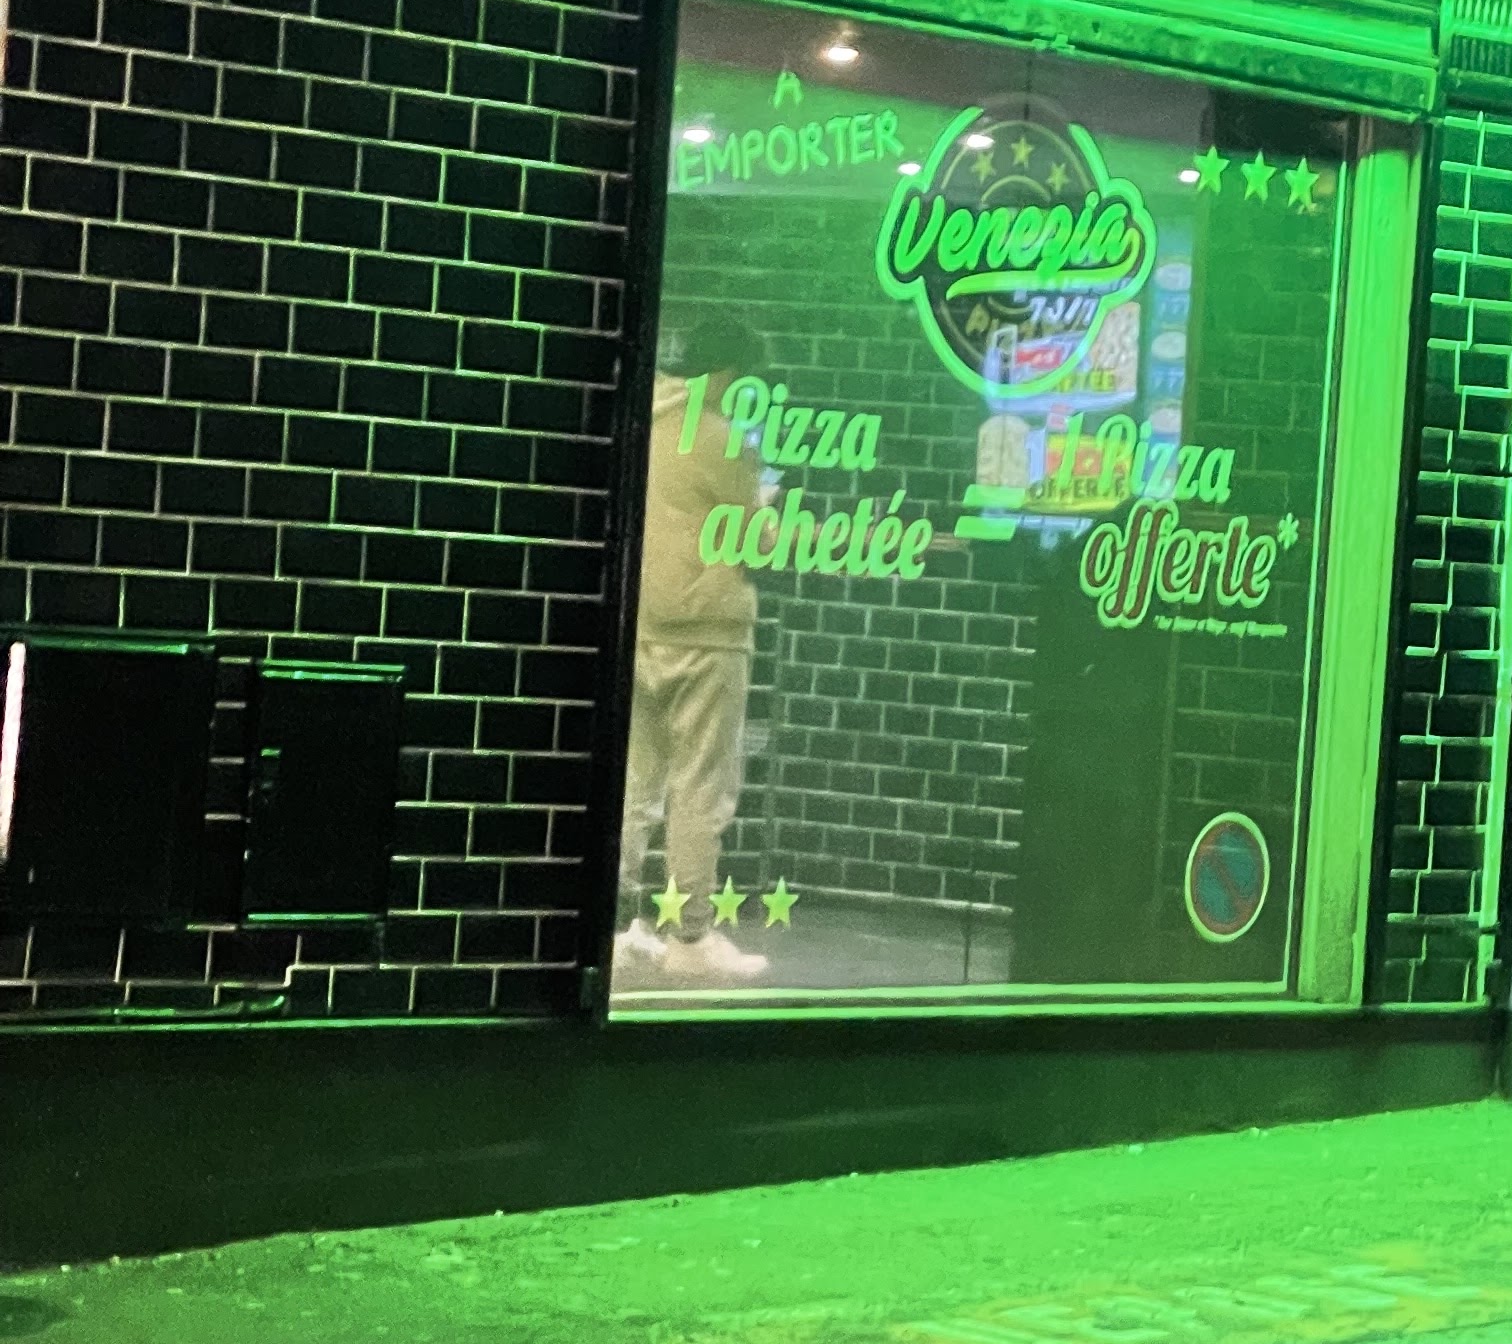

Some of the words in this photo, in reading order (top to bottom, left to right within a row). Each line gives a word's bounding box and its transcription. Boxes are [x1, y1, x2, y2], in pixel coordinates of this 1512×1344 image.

[676, 109, 905, 191] EMPORTER
[894, 191, 1140, 281] Venezia
[678, 374, 709, 457] 1
[721, 377, 883, 473] Pizza
[1057, 412, 1084, 490] 1
[1095, 413, 1237, 503] Pizza
[699, 487, 934, 581] achetée
